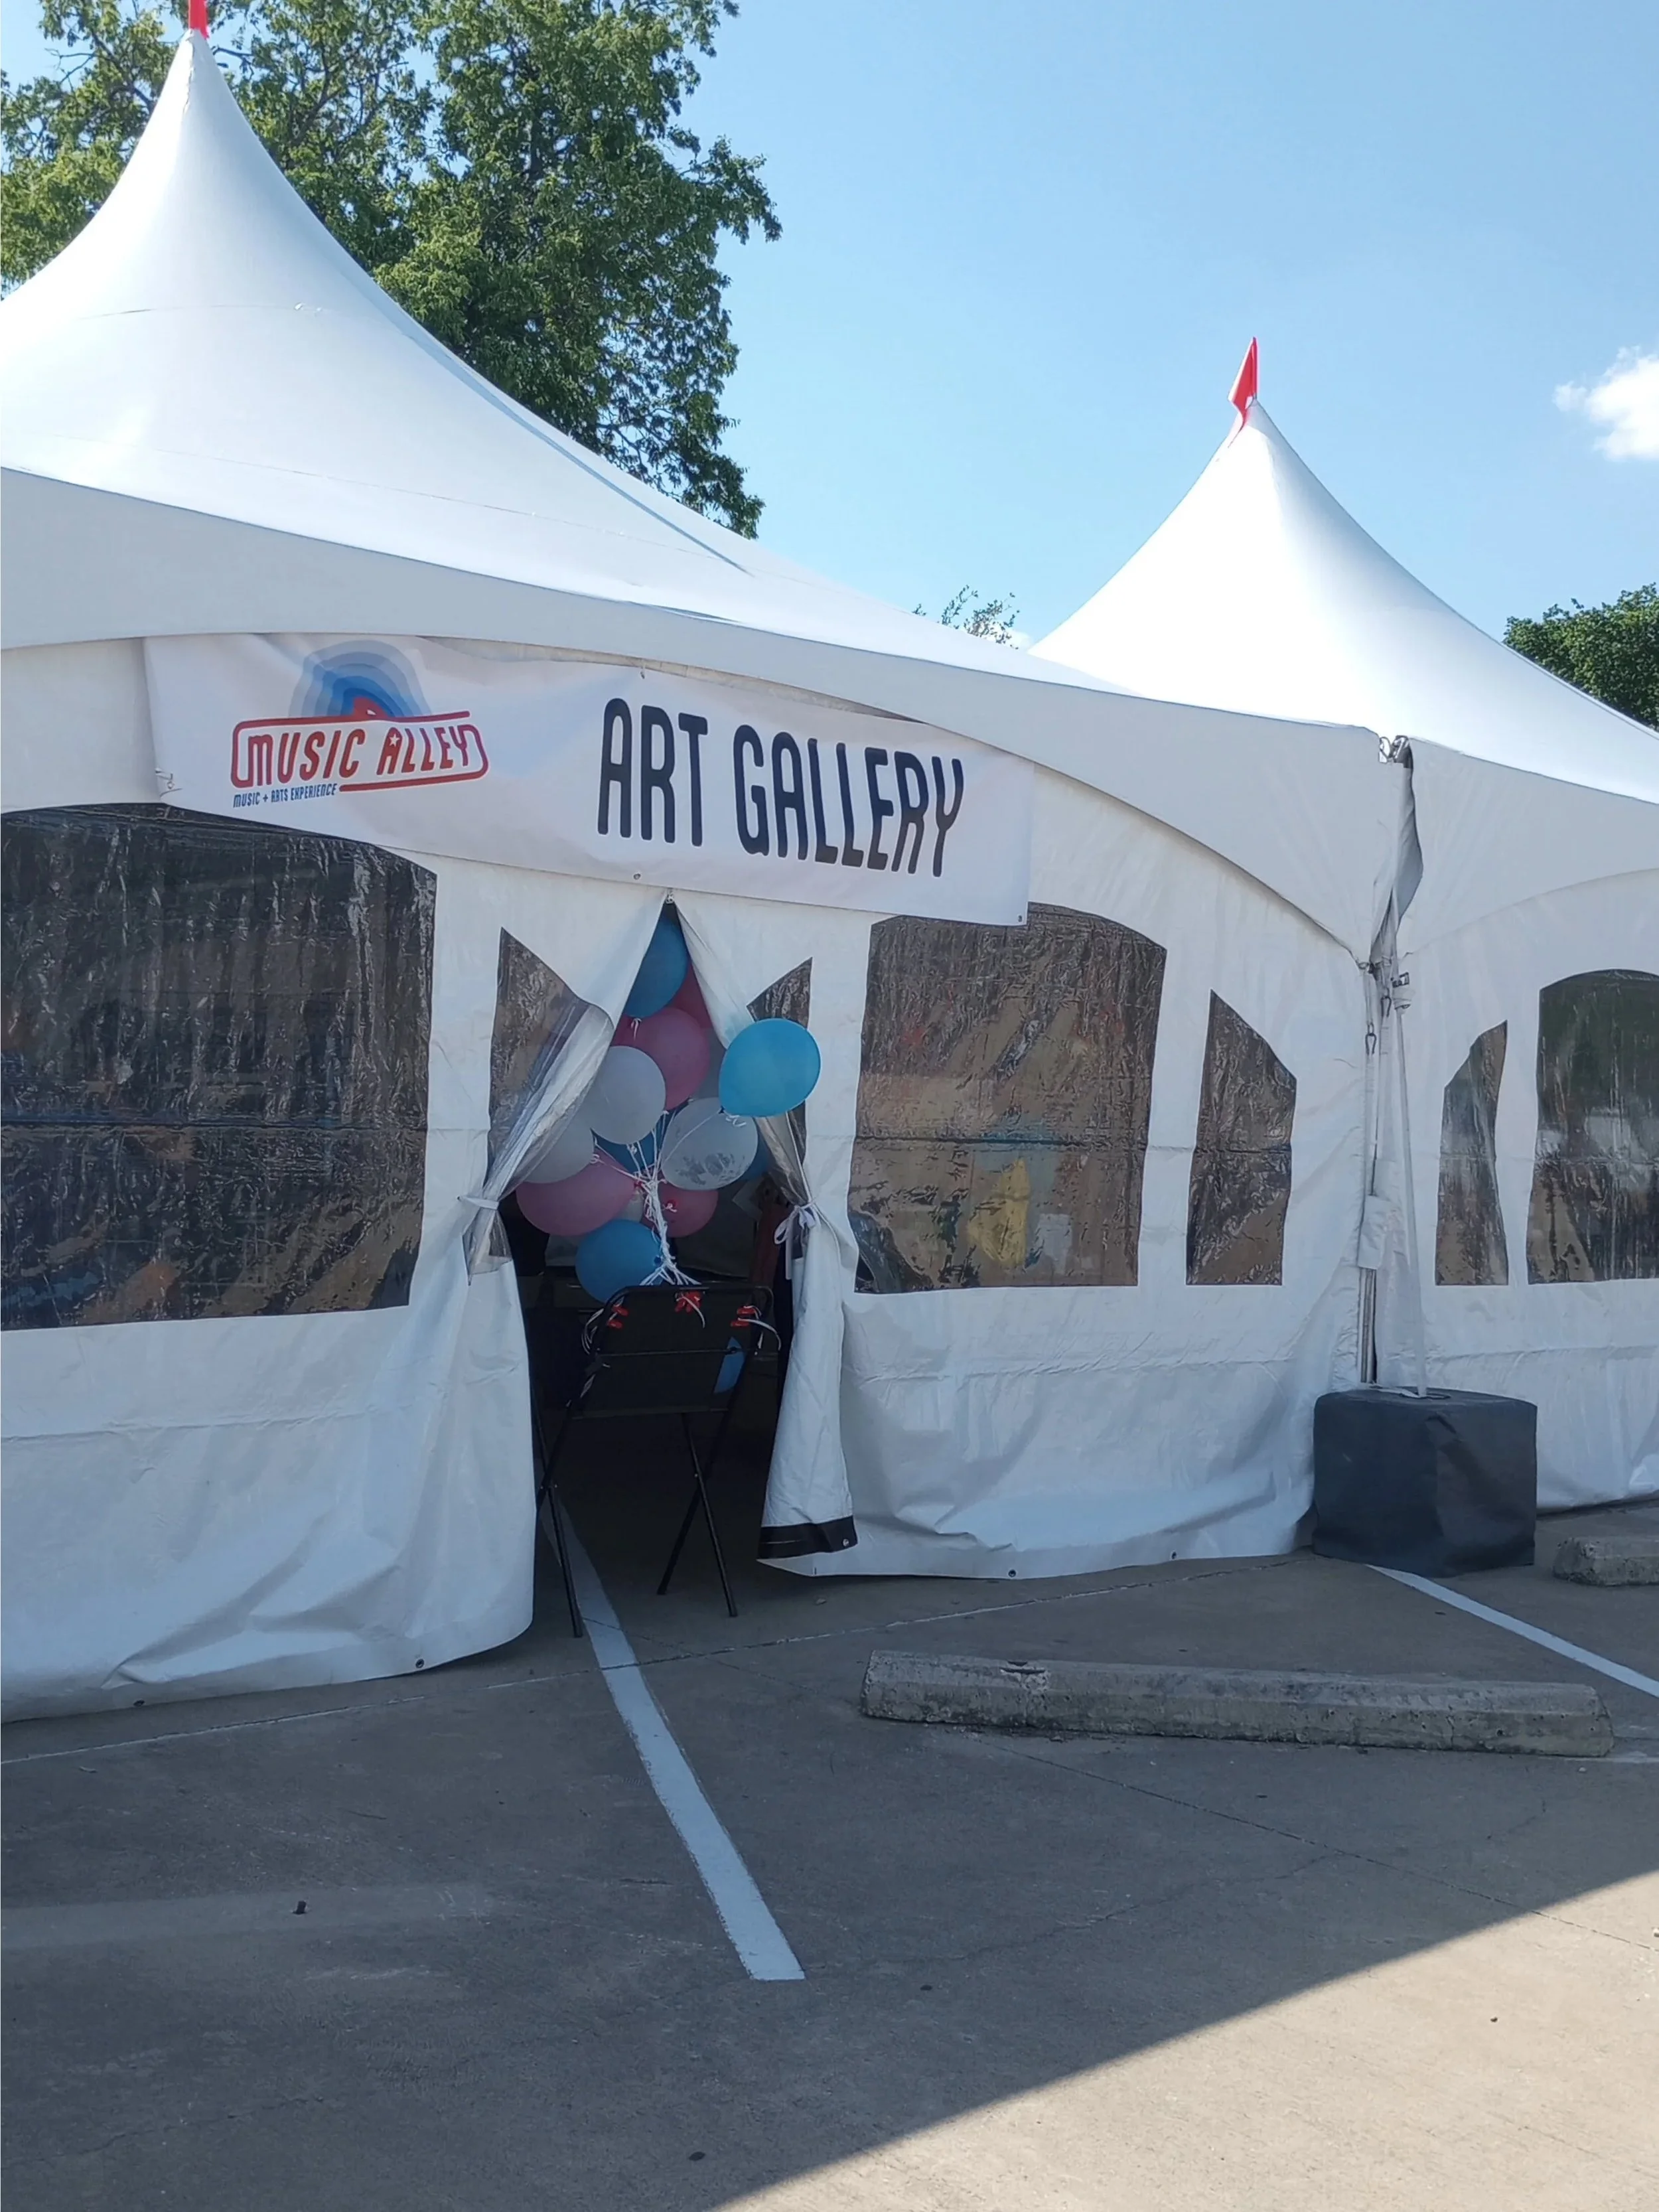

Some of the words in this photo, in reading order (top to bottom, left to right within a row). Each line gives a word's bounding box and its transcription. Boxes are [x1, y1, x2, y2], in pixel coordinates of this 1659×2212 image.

[247, 728, 366, 788] MUSIC
[376, 724, 470, 775] ALLEY
[598, 698, 708, 847] ART
[733, 724, 964, 877] GALLERY
[233, 792, 260, 808] MUSIC
[271, 788, 288, 802] ARTS
[291, 783, 337, 800] EXPERIENCE
